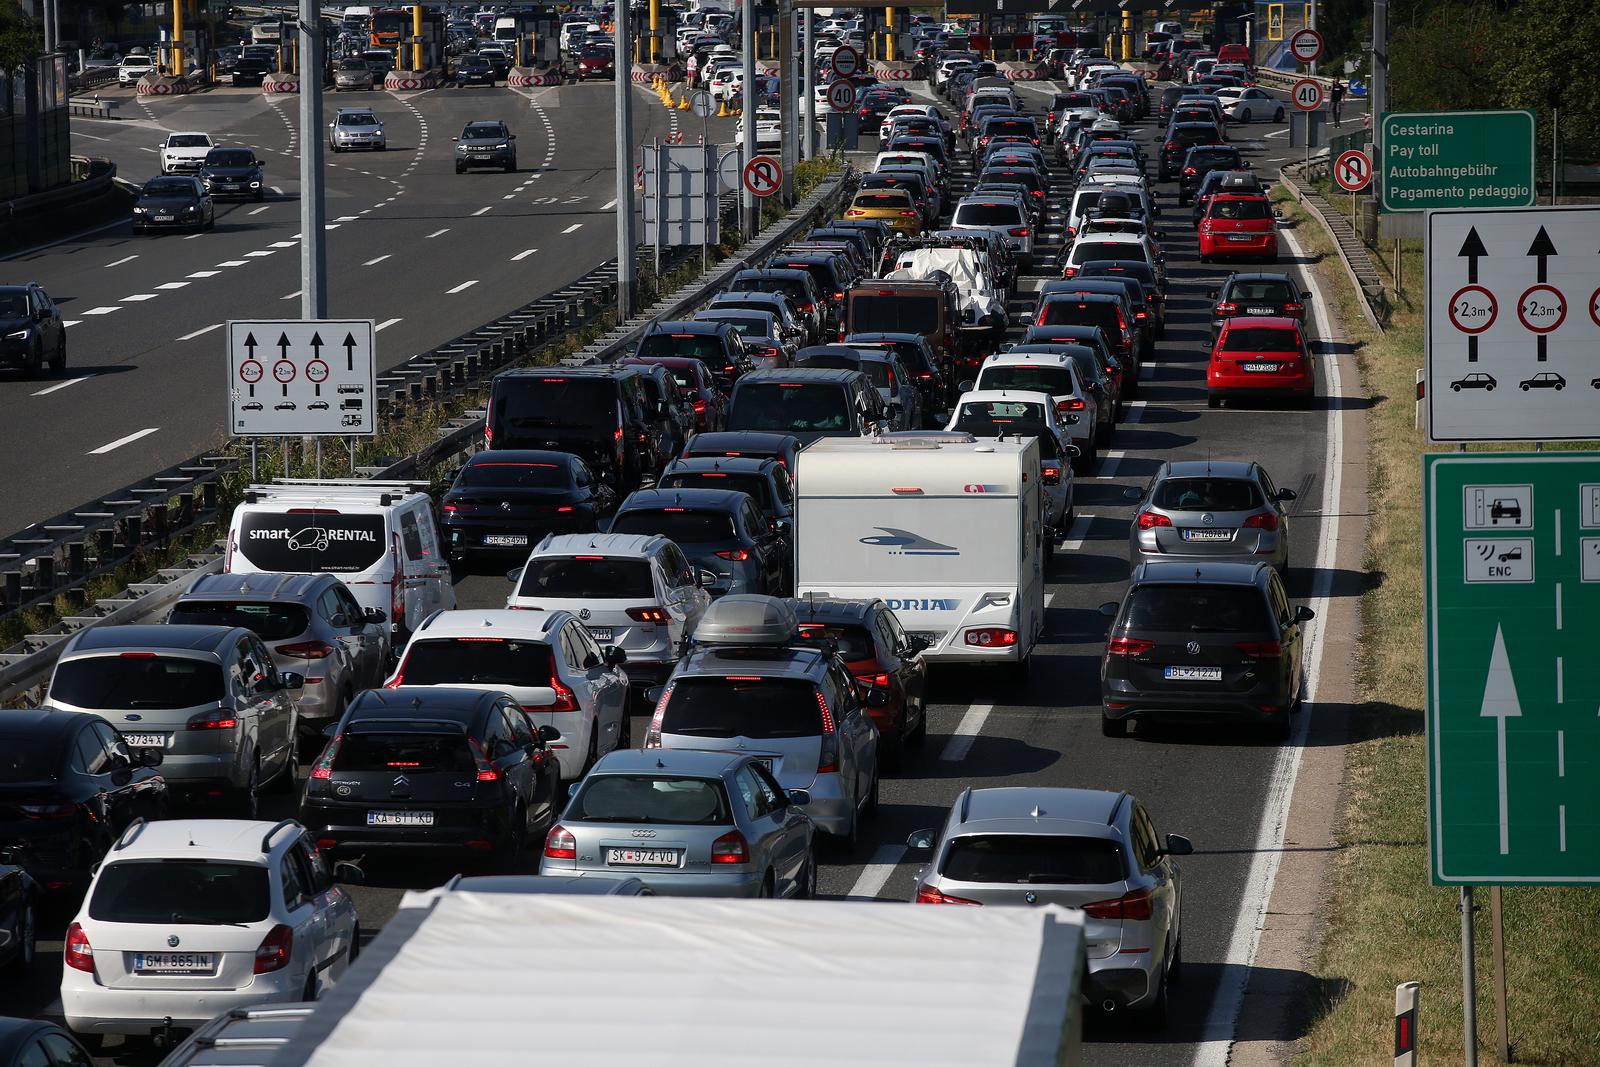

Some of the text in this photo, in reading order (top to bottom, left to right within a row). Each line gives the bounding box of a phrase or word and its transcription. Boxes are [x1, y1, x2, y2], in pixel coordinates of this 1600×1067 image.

[834, 88, 851, 103] 40
[1298, 87, 1317, 103] 40
[1390, 123, 1454, 136] Cestarina
[1390, 143, 1439, 159] Pay toll
[1390, 163, 1498, 180] Autobahngebühr
[1390, 184, 1529, 201] Pagamento pedaggio
[249, 528, 376, 542] smart RENTAL
[1488, 566, 1512, 577] ENC
[884, 599, 945, 610] DRIA
[1172, 666, 1185, 677] BL
[375, 811, 388, 823] KA
[612, 849, 626, 862] SK
[146, 955, 208, 967] GM 865 IN
